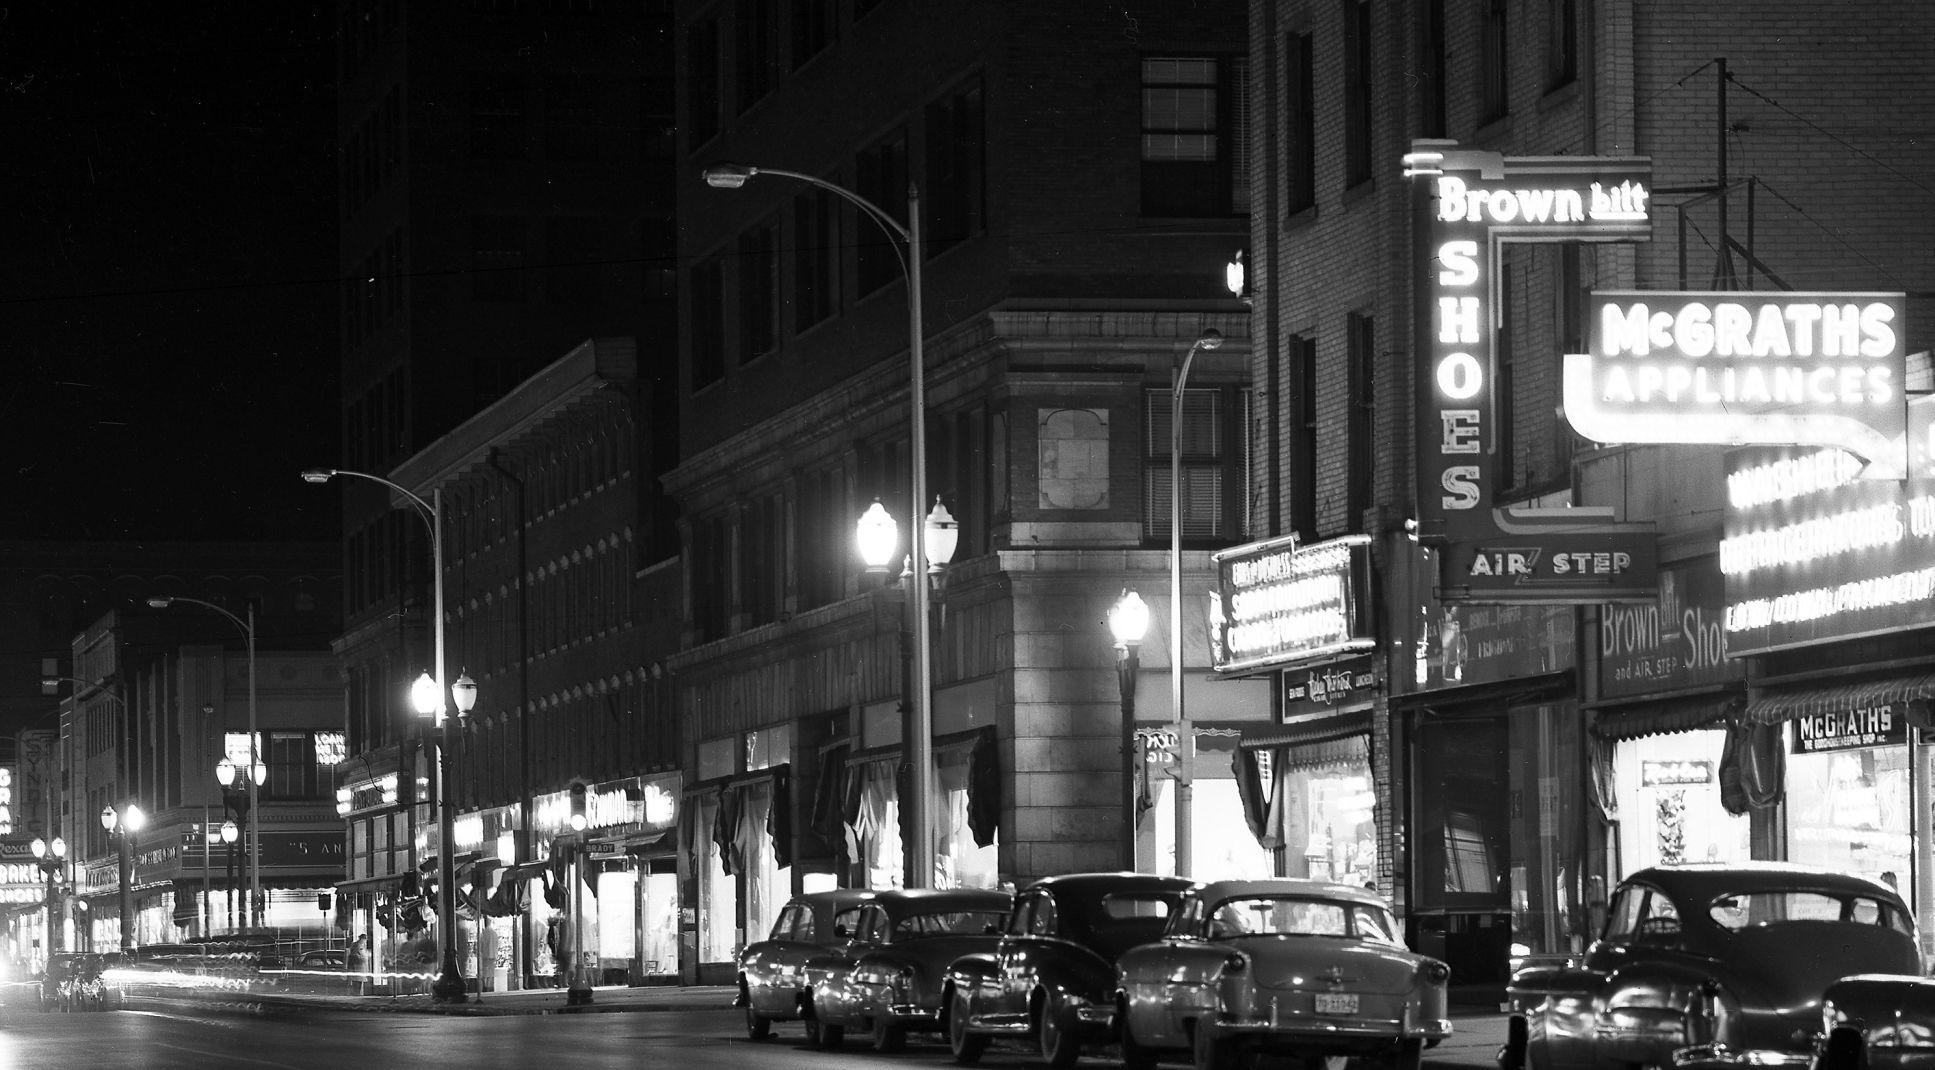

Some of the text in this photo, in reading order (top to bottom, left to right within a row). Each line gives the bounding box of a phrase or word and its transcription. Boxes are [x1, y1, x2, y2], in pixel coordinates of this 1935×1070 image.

[1438, 176, 1648, 223] Brown bilt
[1602, 302, 1897, 358] McGRATHS
[1437, 240, 1482, 510] SHOES
[1602, 367, 1894, 404] APPLIANCES
[1470, 552, 1631, 576] AIR STEP
[1601, 604, 1659, 656] Brown
[1615, 657, 1678, 680] and AIR STEP
[1800, 705, 1892, 740] McGRATH'S
[586, 844, 614, 853] BRADY
